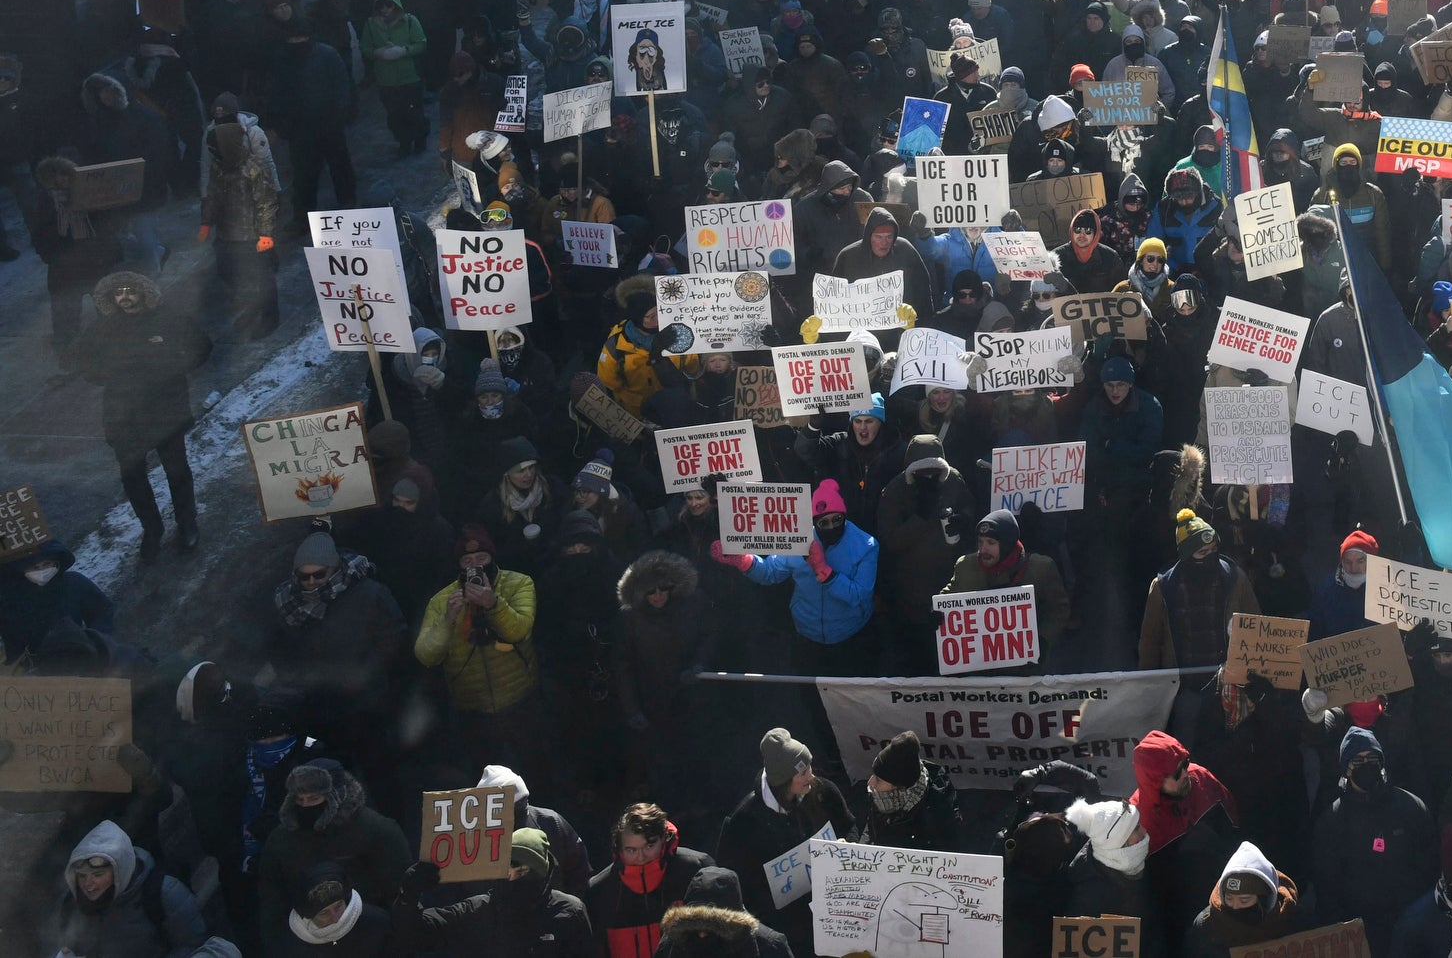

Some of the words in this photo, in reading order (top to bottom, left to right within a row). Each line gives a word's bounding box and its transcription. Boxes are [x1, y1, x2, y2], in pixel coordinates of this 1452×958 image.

[618, 20, 651, 30] MELT
[654, 19, 675, 27] ICE
[1089, 81, 1142, 97] WHERE
[1379, 138, 1413, 154] ICE
[922, 160, 946, 179] ICE
[965, 159, 998, 178] OUT
[1394, 157, 1441, 174] MSP
[941, 184, 978, 203] FOR
[1244, 189, 1281, 215] ICE
[691, 203, 760, 227] RESPECT
[569, 227, 605, 239] BELIEVE
[727, 225, 793, 247] HUMAN
[460, 235, 504, 254] NO
[578, 240, 600, 251] YOUR
[329, 256, 368, 277] NO
[441, 254, 524, 274] Justice
[461, 274, 505, 295] NO
[341, 303, 374, 321] NO
[1221, 319, 1270, 343] JUSTICE
[1273, 331, 1298, 351] FOR
[1218, 333, 1257, 354] RENEE
[1259, 345, 1293, 364] GOOD
[789, 360, 817, 377] ICE
[818, 358, 850, 375] OUT
[791, 377, 814, 394] OF
[818, 374, 853, 391] MN!
[1314, 379, 1361, 407] ICE
[1312, 402, 1358, 425] OUT
[673, 443, 702, 460] ICE
[708, 438, 741, 455] OUT
[677, 460, 700, 476] OF
[708, 453, 744, 472] MN!
[731, 496, 759, 513] ICE
[765, 496, 797, 513] OUT
[733, 515, 759, 532] OF
[764, 514, 799, 532] MN!
[942, 638, 976, 666] OF
[980, 630, 1034, 663] MN!
[925, 710, 990, 739] ICE
[1011, 709, 1081, 738] OFF
[434, 792, 504, 832] ICE
[430, 828, 505, 868] OUT
